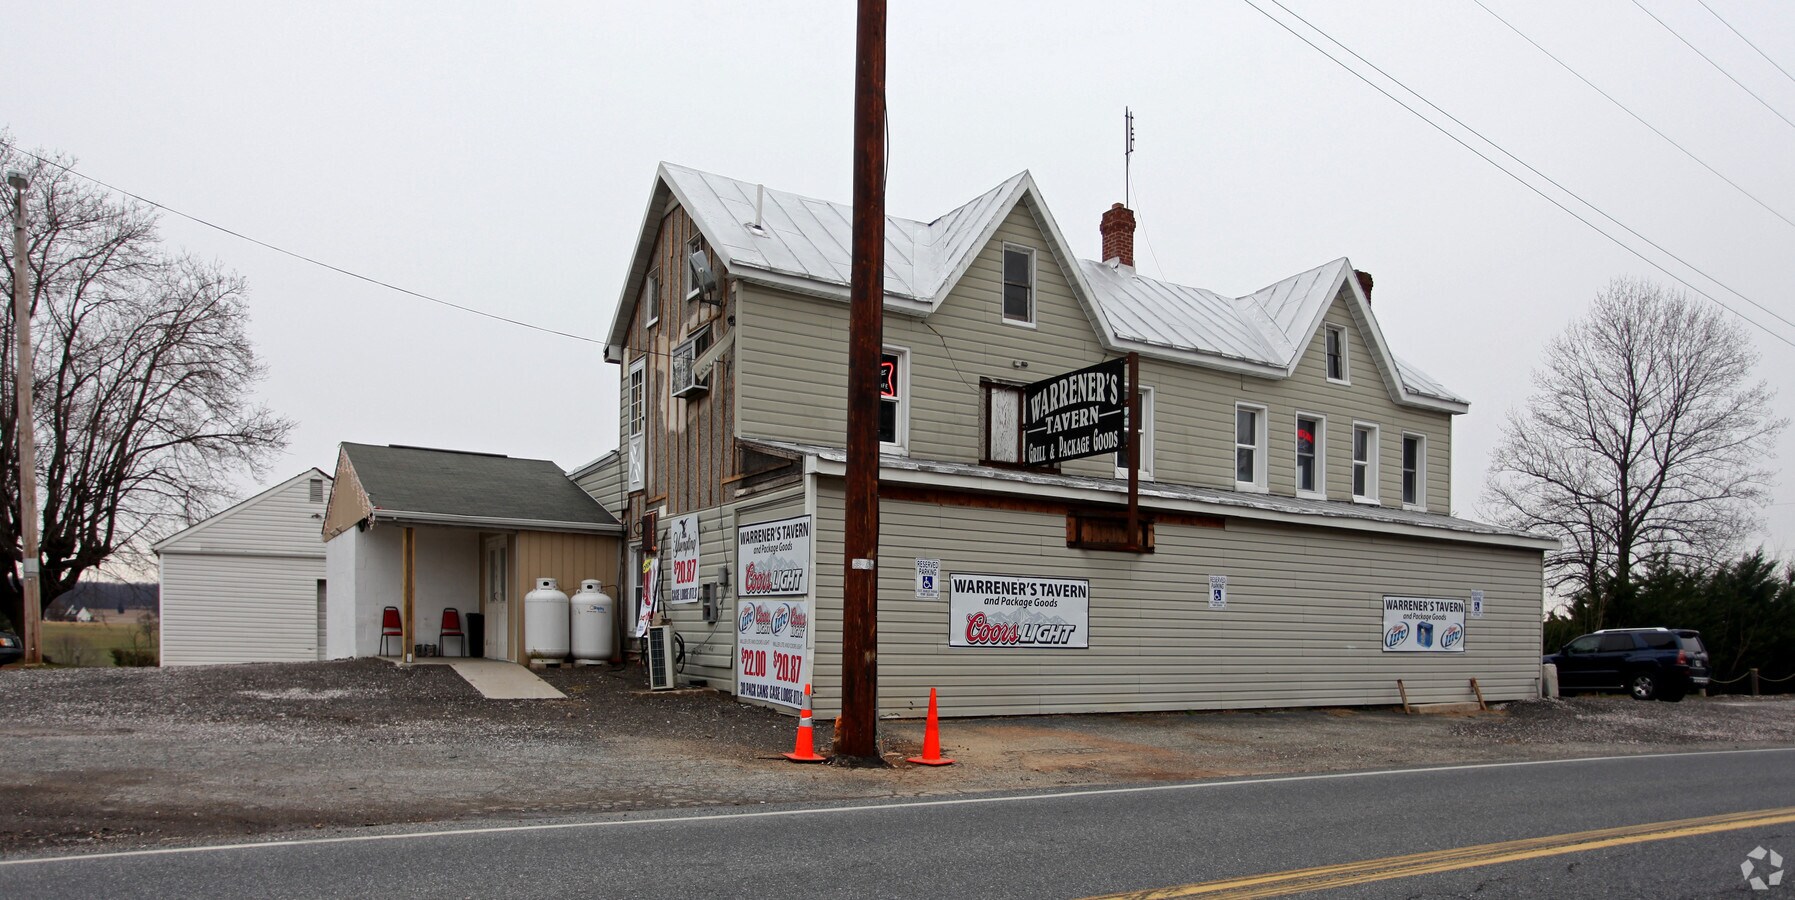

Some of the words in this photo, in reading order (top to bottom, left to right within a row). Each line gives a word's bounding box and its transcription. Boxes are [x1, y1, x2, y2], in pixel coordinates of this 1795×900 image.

[1031, 373, 1117, 423] WARRENER'S
[1046, 405, 1099, 434] TAVERN
[1029, 443, 1046, 463] GRILL
[1050, 443, 1055, 460] &
[1059, 436, 1089, 457] PACKAGE
[1093, 428, 1118, 451] GOODS
[740, 526, 781, 545] WARRENER'S
[782, 522, 809, 539] TAVERN
[762, 543, 778, 555] Package
[779, 541, 792, 552] Goods
[674, 558, 697, 584] $20.87
[917, 560, 938, 569] RESERVED
[919, 568, 936, 576] PARKING
[745, 561, 772, 594] Coors
[771, 568, 803, 592] LIGHT
[954, 579, 1037, 596] WARRENER'S
[1040, 583, 1086, 598] TAVERN
[984, 597, 1000, 605] and
[1001, 597, 1032, 608] Package
[1034, 598, 1058, 607] Goods
[1386, 599, 1434, 611] WARRENER'S
[1436, 602, 1463, 612] TAVERN
[1413, 613, 1431, 621] Package
[965, 611, 1020, 645] Coors
[1019, 624, 1076, 644] LIGHT
[1389, 629, 1406, 647] Lite
[1445, 630, 1460, 647] Lite
[741, 647, 766, 677] $22.00
[773, 650, 802, 683] $20.87
[746, 683, 756, 697] PACK
[757, 684, 768, 698] CANS
[769, 685, 780, 700] CASE
